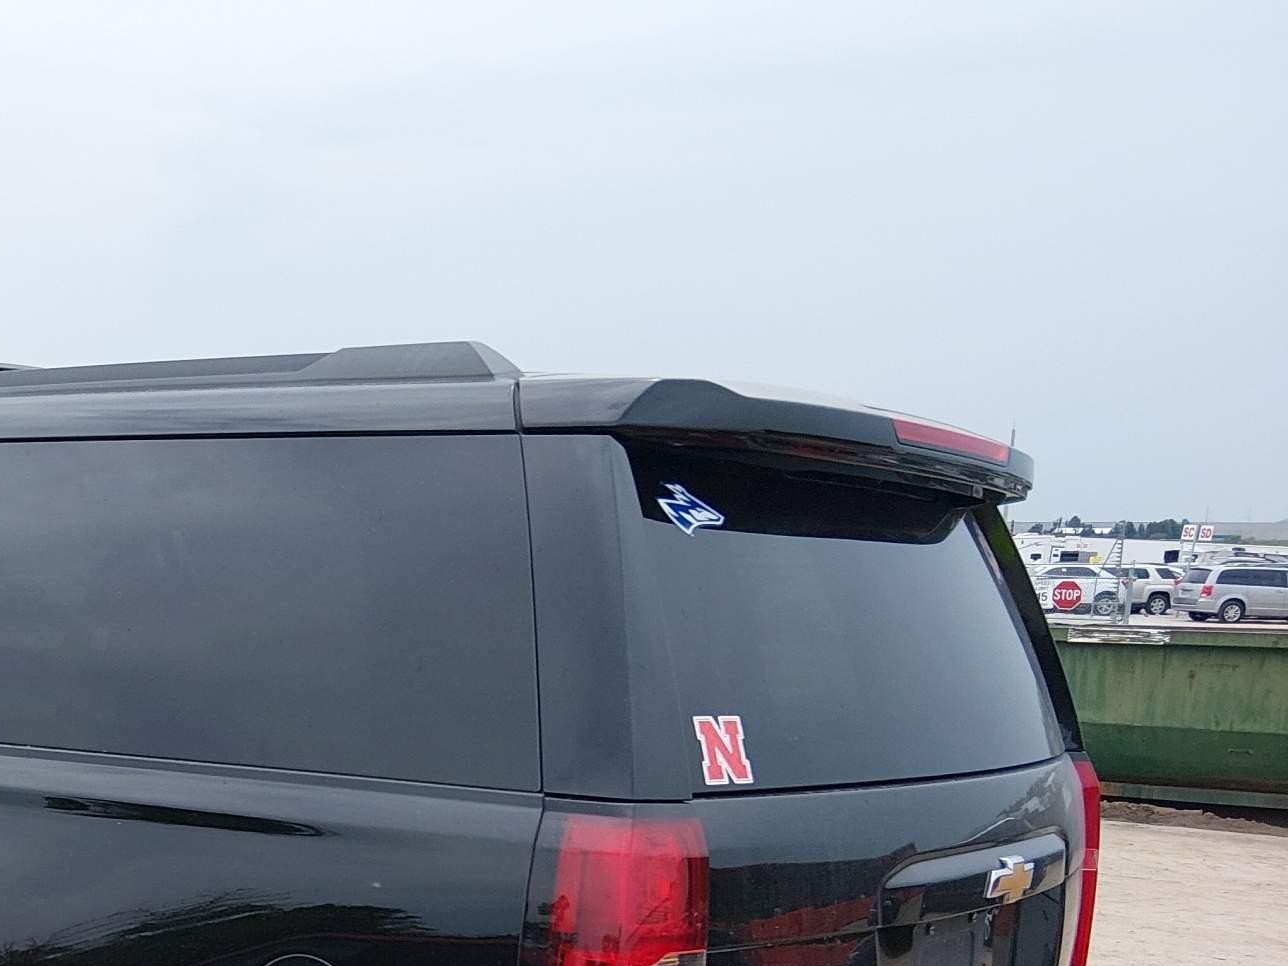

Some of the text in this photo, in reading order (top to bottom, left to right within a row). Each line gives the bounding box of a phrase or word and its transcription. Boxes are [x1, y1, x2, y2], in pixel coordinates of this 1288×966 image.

[1183, 527, 1195, 538] SC
[1200, 527, 1212, 539] SD
[1053, 589, 1081, 601] STOP
[693, 716, 754, 786] N
